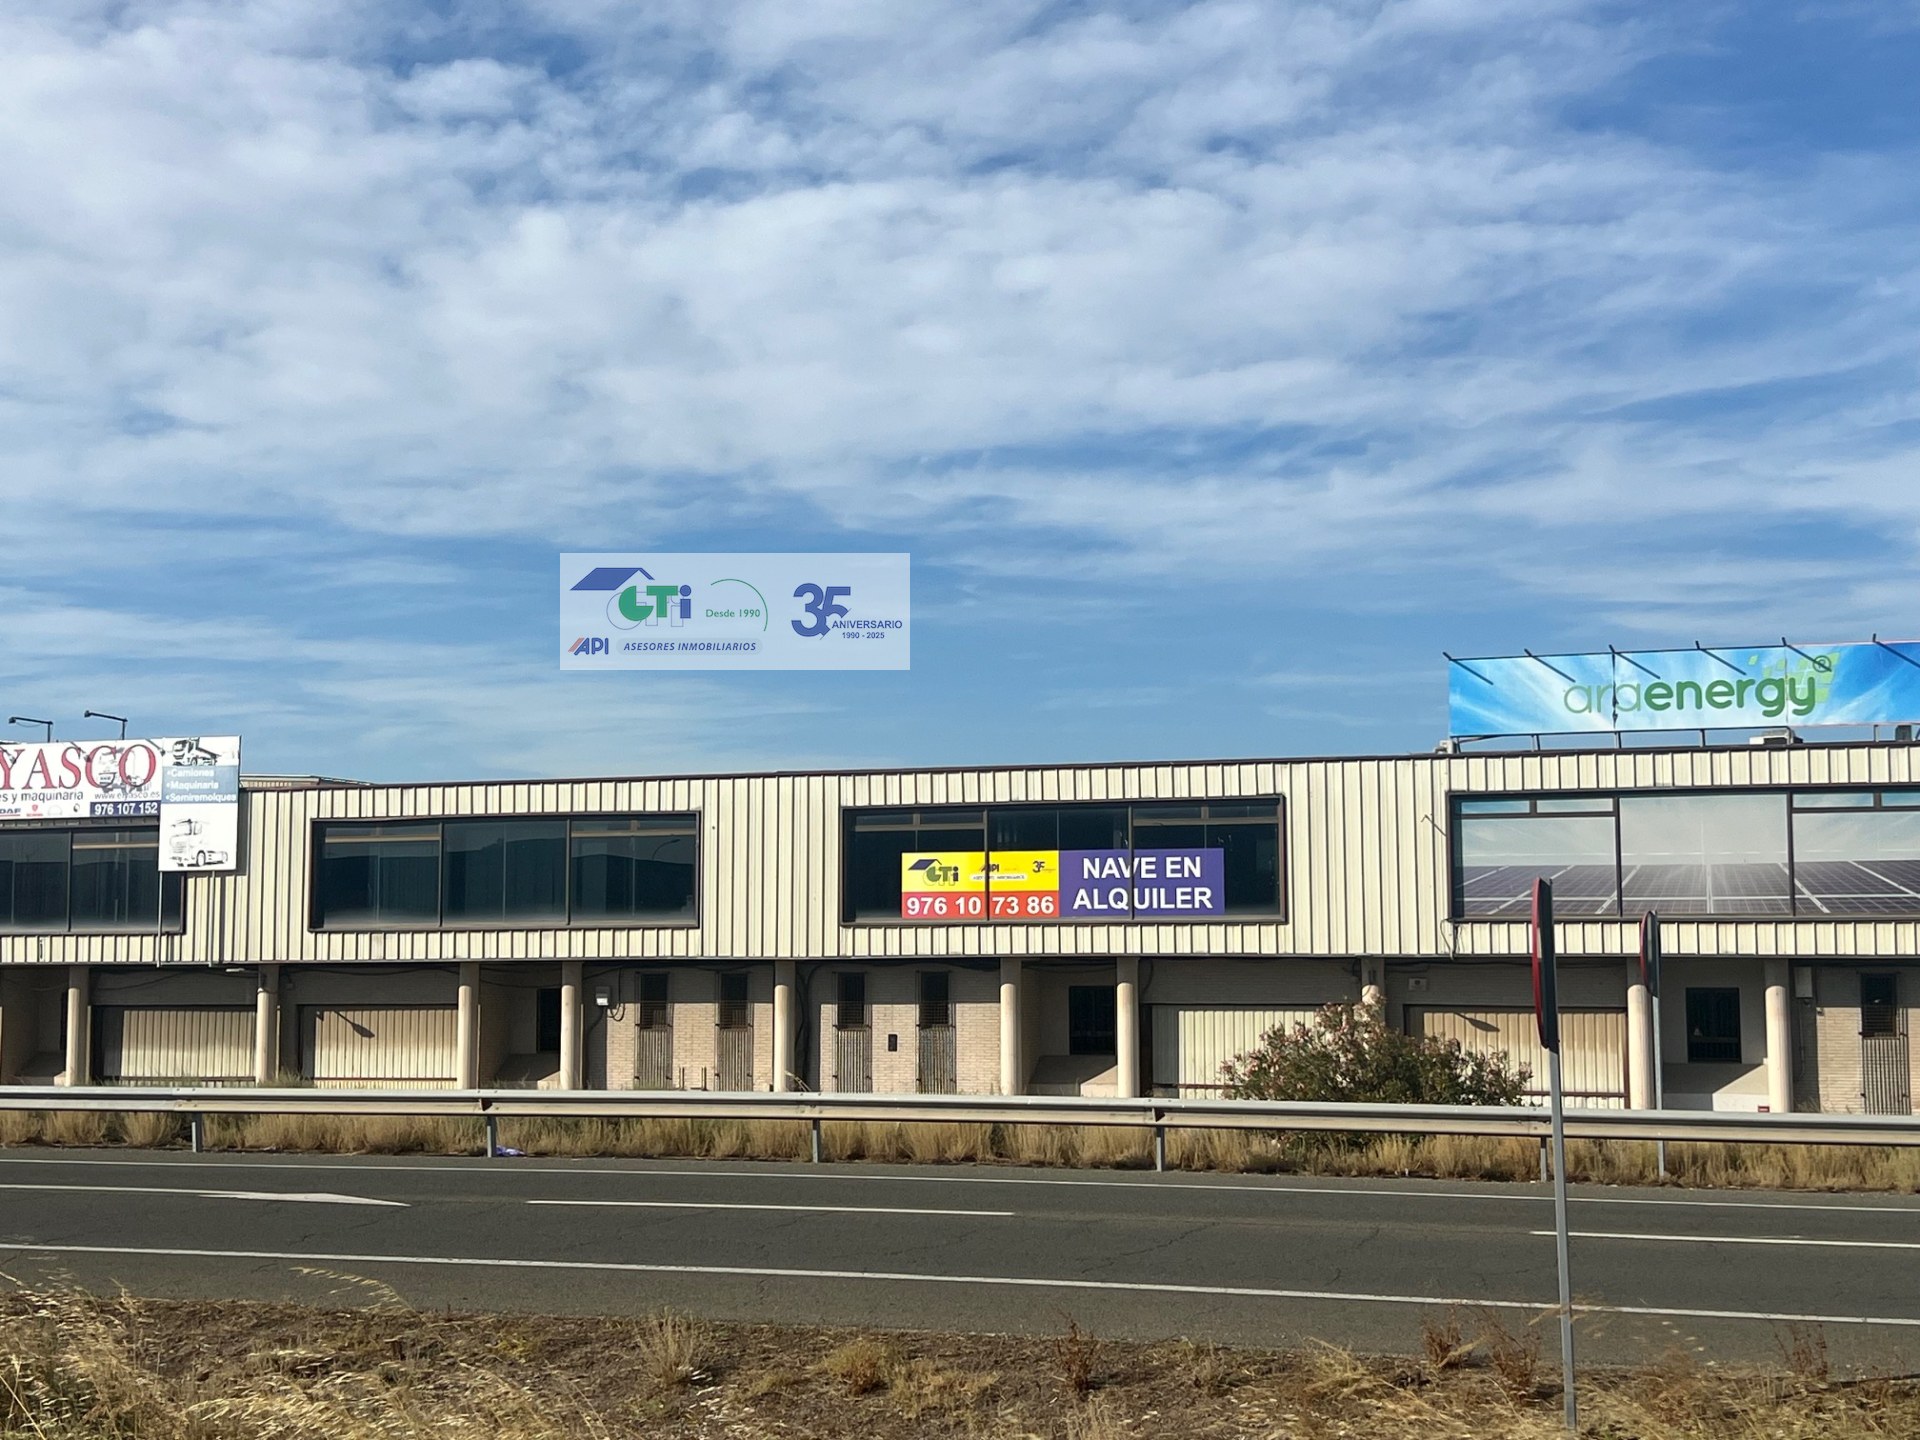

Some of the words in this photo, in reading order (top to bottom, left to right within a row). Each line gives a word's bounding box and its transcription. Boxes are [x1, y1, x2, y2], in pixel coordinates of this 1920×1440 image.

[1563, 676, 1816, 718] araenergy
[0, 745, 157, 790] YASCO
[11, 793, 18, 804] y
[21, 791, 84, 803] maquinaria
[94, 804, 114, 815] 976
[117, 803, 136, 815] 107
[139, 802, 158, 814] 152
[1083, 857, 1157, 879] NAVE
[1165, 856, 1202, 877] EN
[907, 897, 948, 915] 976
[955, 896, 981, 915] 10
[992, 896, 1019, 914] 73
[1026, 896, 1055, 914] 86
[1072, 887, 1213, 910] ALQUILER
